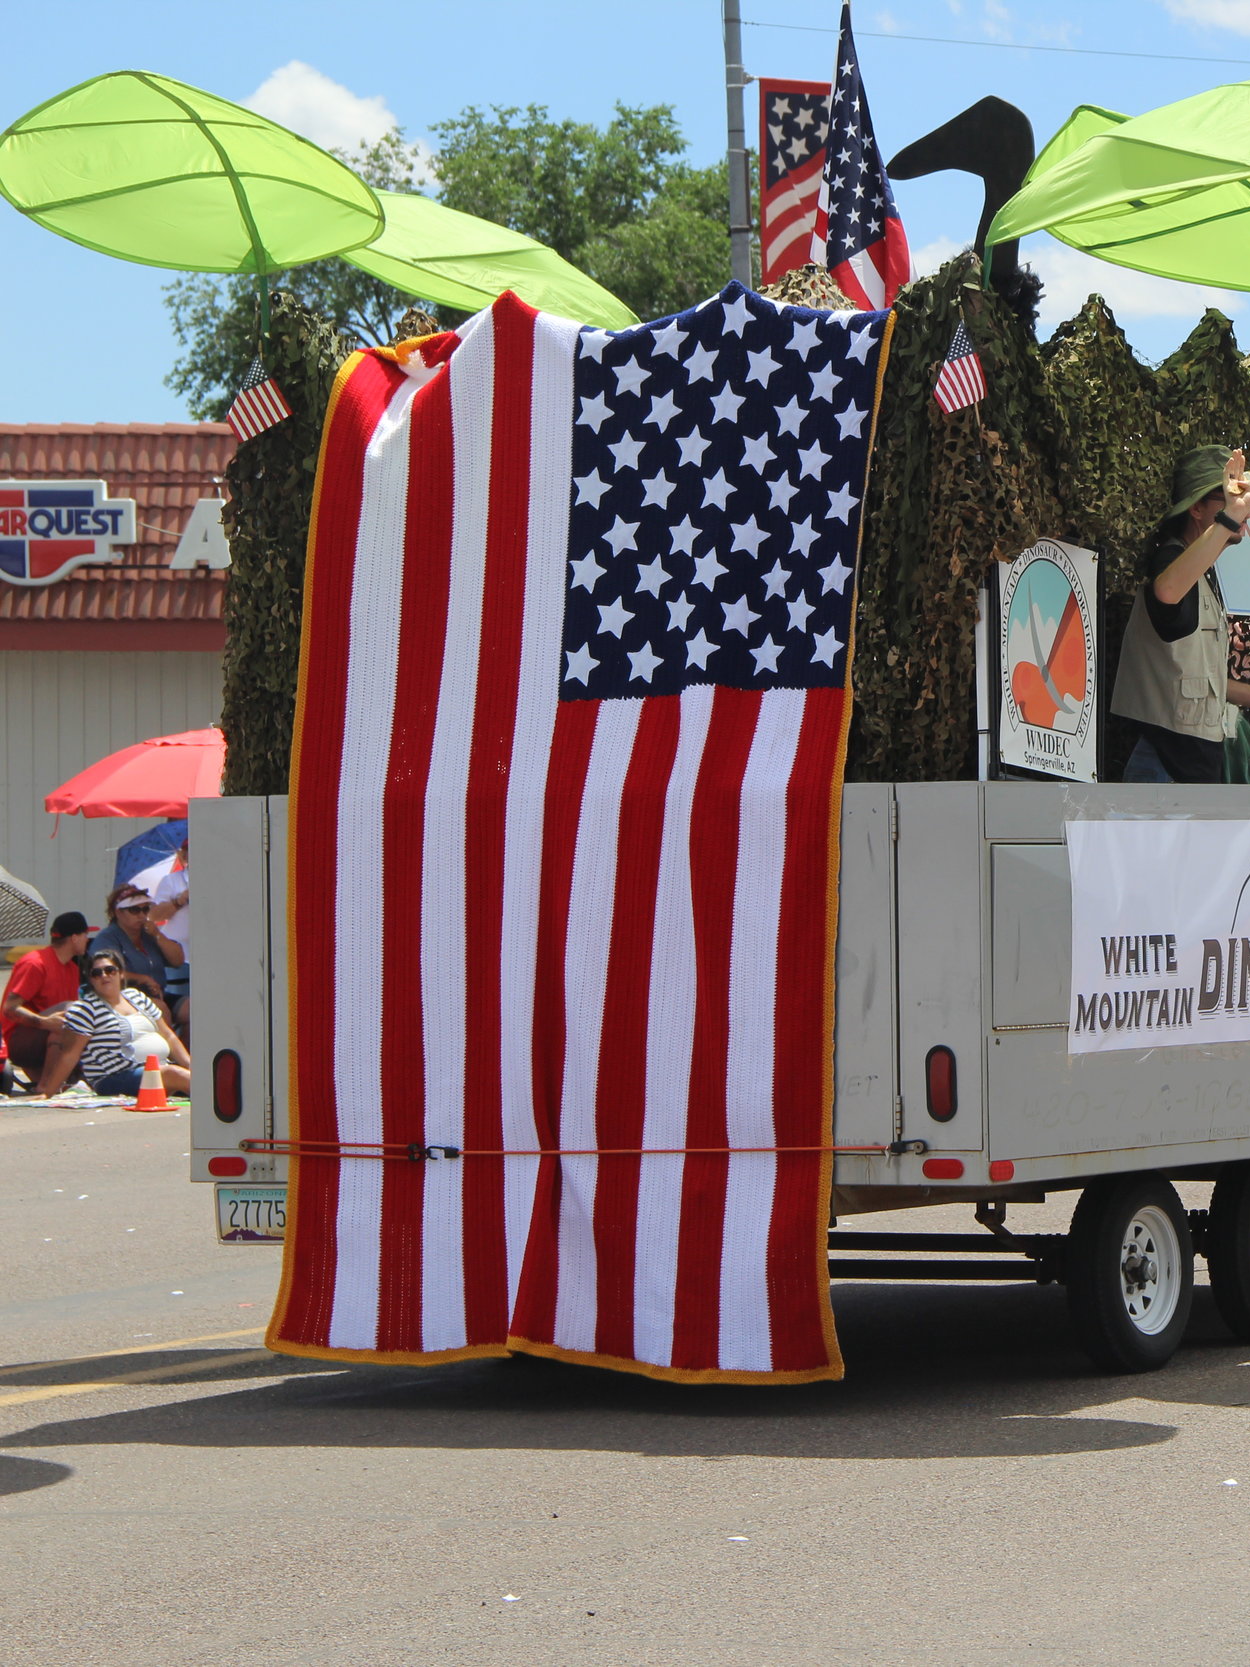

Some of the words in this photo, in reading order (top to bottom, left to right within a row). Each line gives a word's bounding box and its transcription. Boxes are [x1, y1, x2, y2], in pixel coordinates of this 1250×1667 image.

[1022, 544, 1059, 566] DINOSAUR
[1002, 566, 1020, 648] MOUNTAIN
[1063, 560, 1094, 661] EXPLORATION
[1078, 678, 1094, 738] CENTER
[1024, 750, 1067, 774] Springerville,
[1067, 761, 1076, 774] AZ
[1026, 728, 1071, 759] WMDEC
[1100, 934, 1178, 977] WHITE
[1074, 987, 1194, 1035] MOUNTAIN
[229, 1200, 286, 1228] 27775
